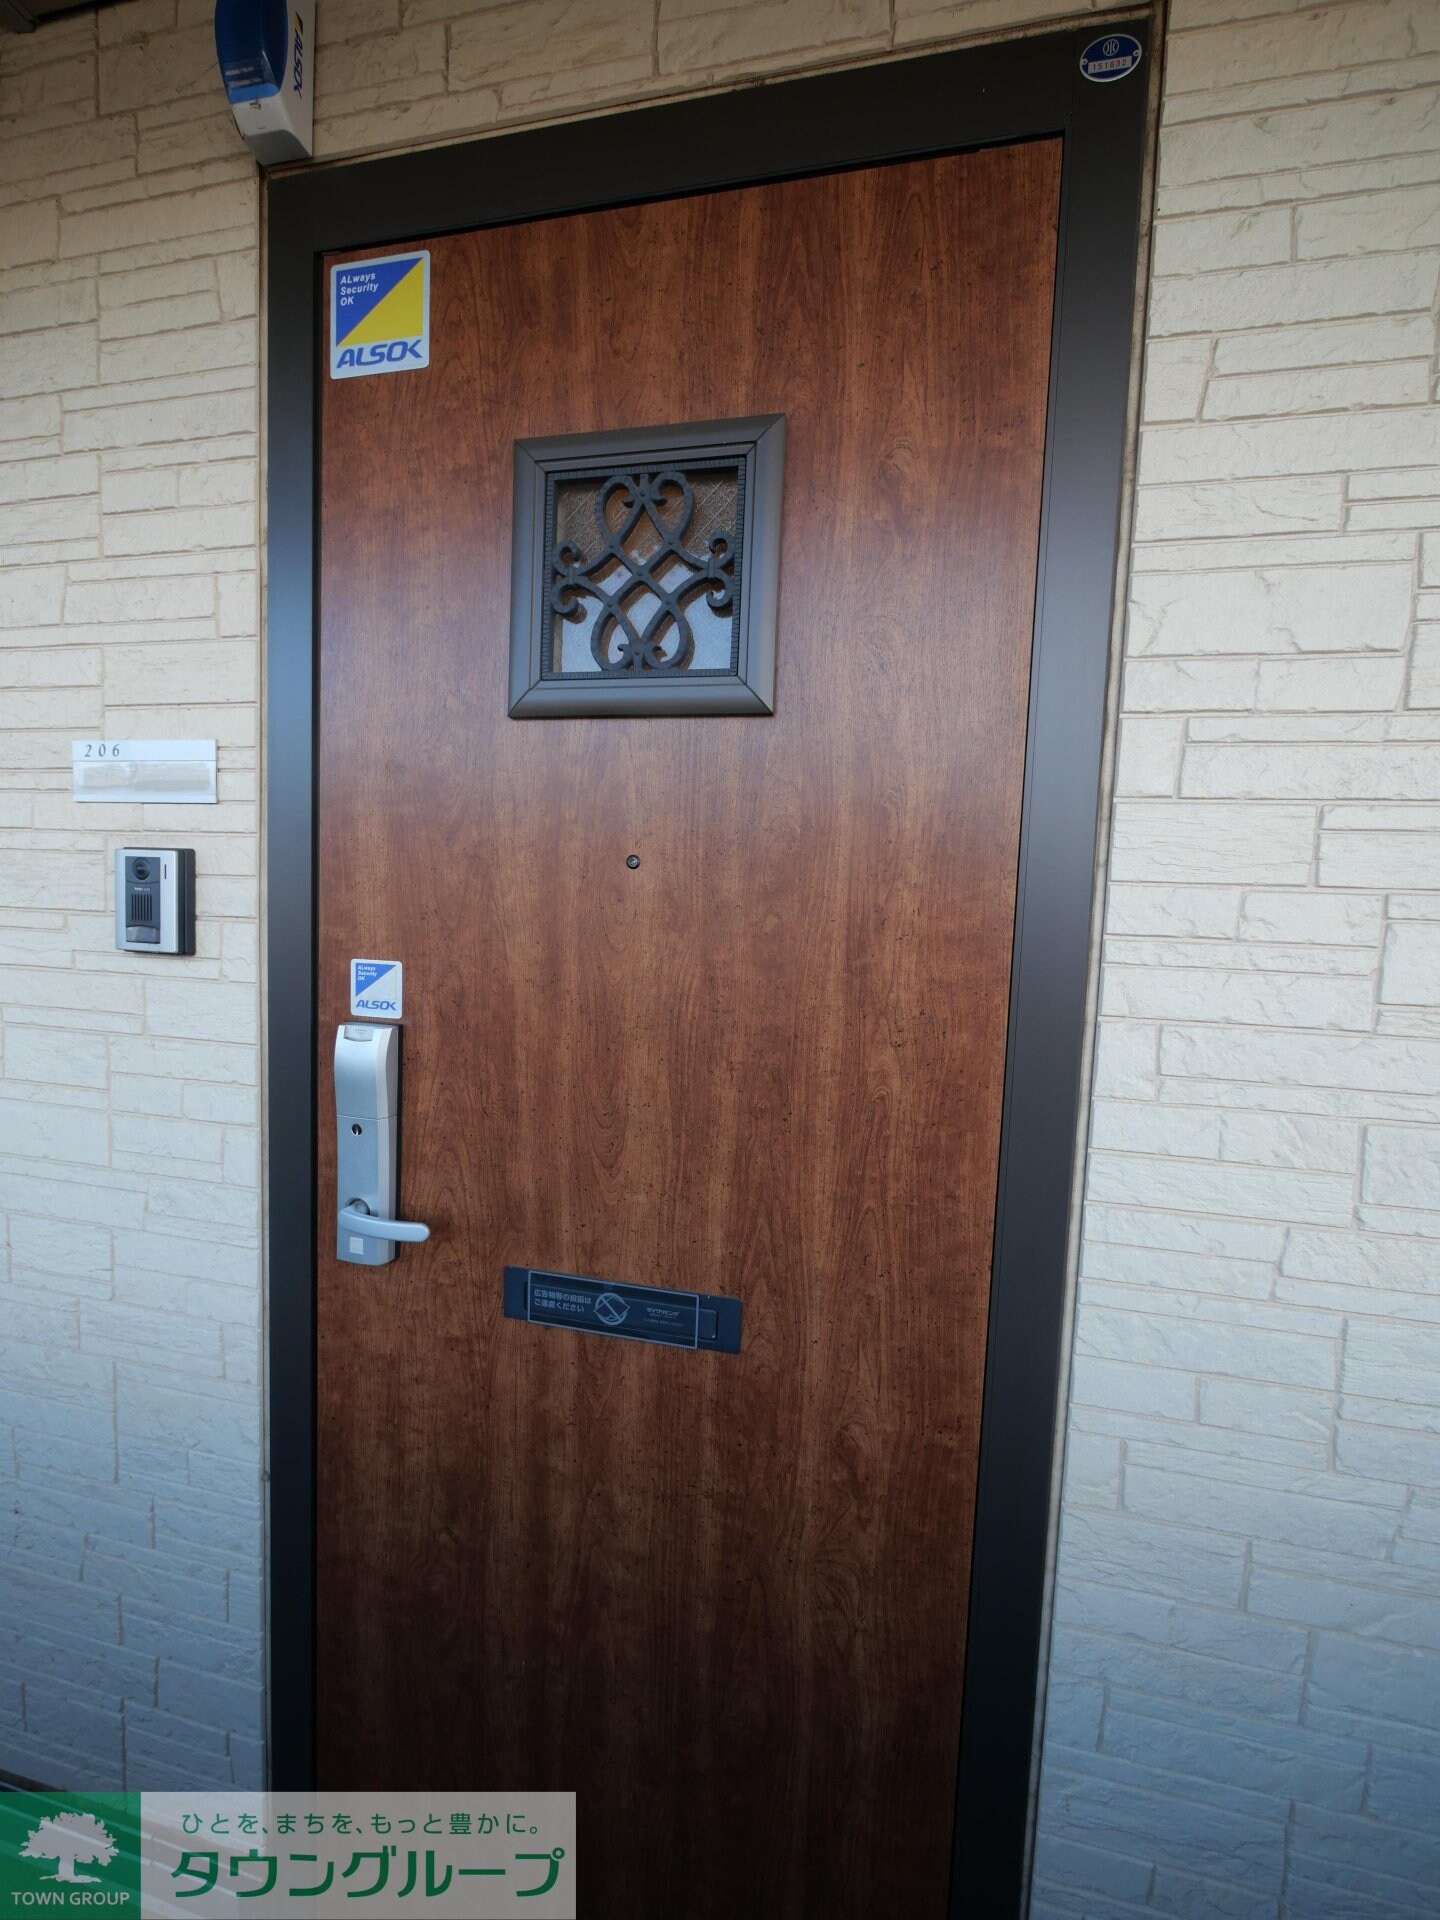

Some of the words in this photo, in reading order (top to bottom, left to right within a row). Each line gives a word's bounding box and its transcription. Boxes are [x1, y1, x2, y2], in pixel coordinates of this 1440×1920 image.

[293, 28, 303, 98] ALSOK
[340, 273, 376, 285] ALways
[340, 283, 379, 296] Security
[340, 296, 354, 306] OK
[336, 339, 423, 369] ALSOK
[84, 743, 121, 758] 206
[356, 999, 397, 1011] ALSOK
